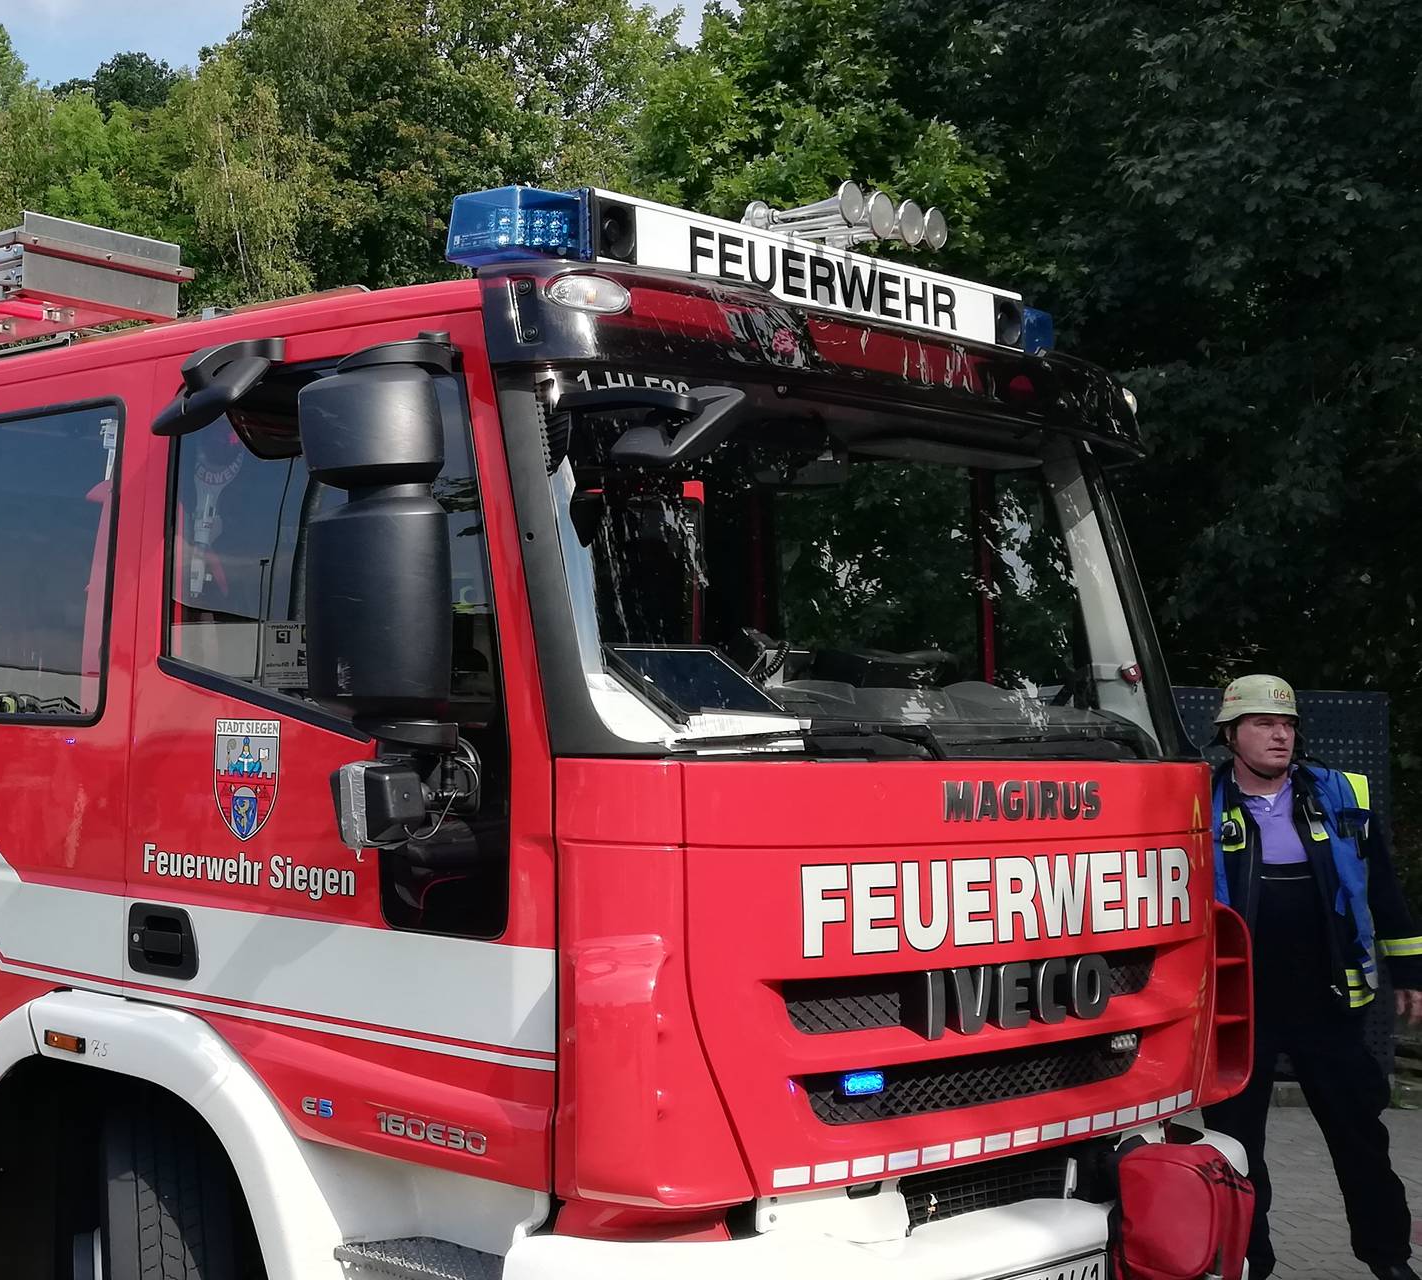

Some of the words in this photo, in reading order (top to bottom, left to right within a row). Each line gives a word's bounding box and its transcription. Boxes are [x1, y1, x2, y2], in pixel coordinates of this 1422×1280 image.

[688, 226, 957, 331] FEUERWEHR
[217, 720, 245, 734] STADT
[245, 721, 279, 735] SIEGEN
[943, 780, 1102, 822] MAGIRUS
[143, 843, 263, 887] Feuerwehr
[269, 854, 356, 901] Siegen
[800, 847, 1191, 959] FEUERWEHR
[926, 954, 1111, 1041] IVECO
[377, 1111, 488, 1156] 160E30
